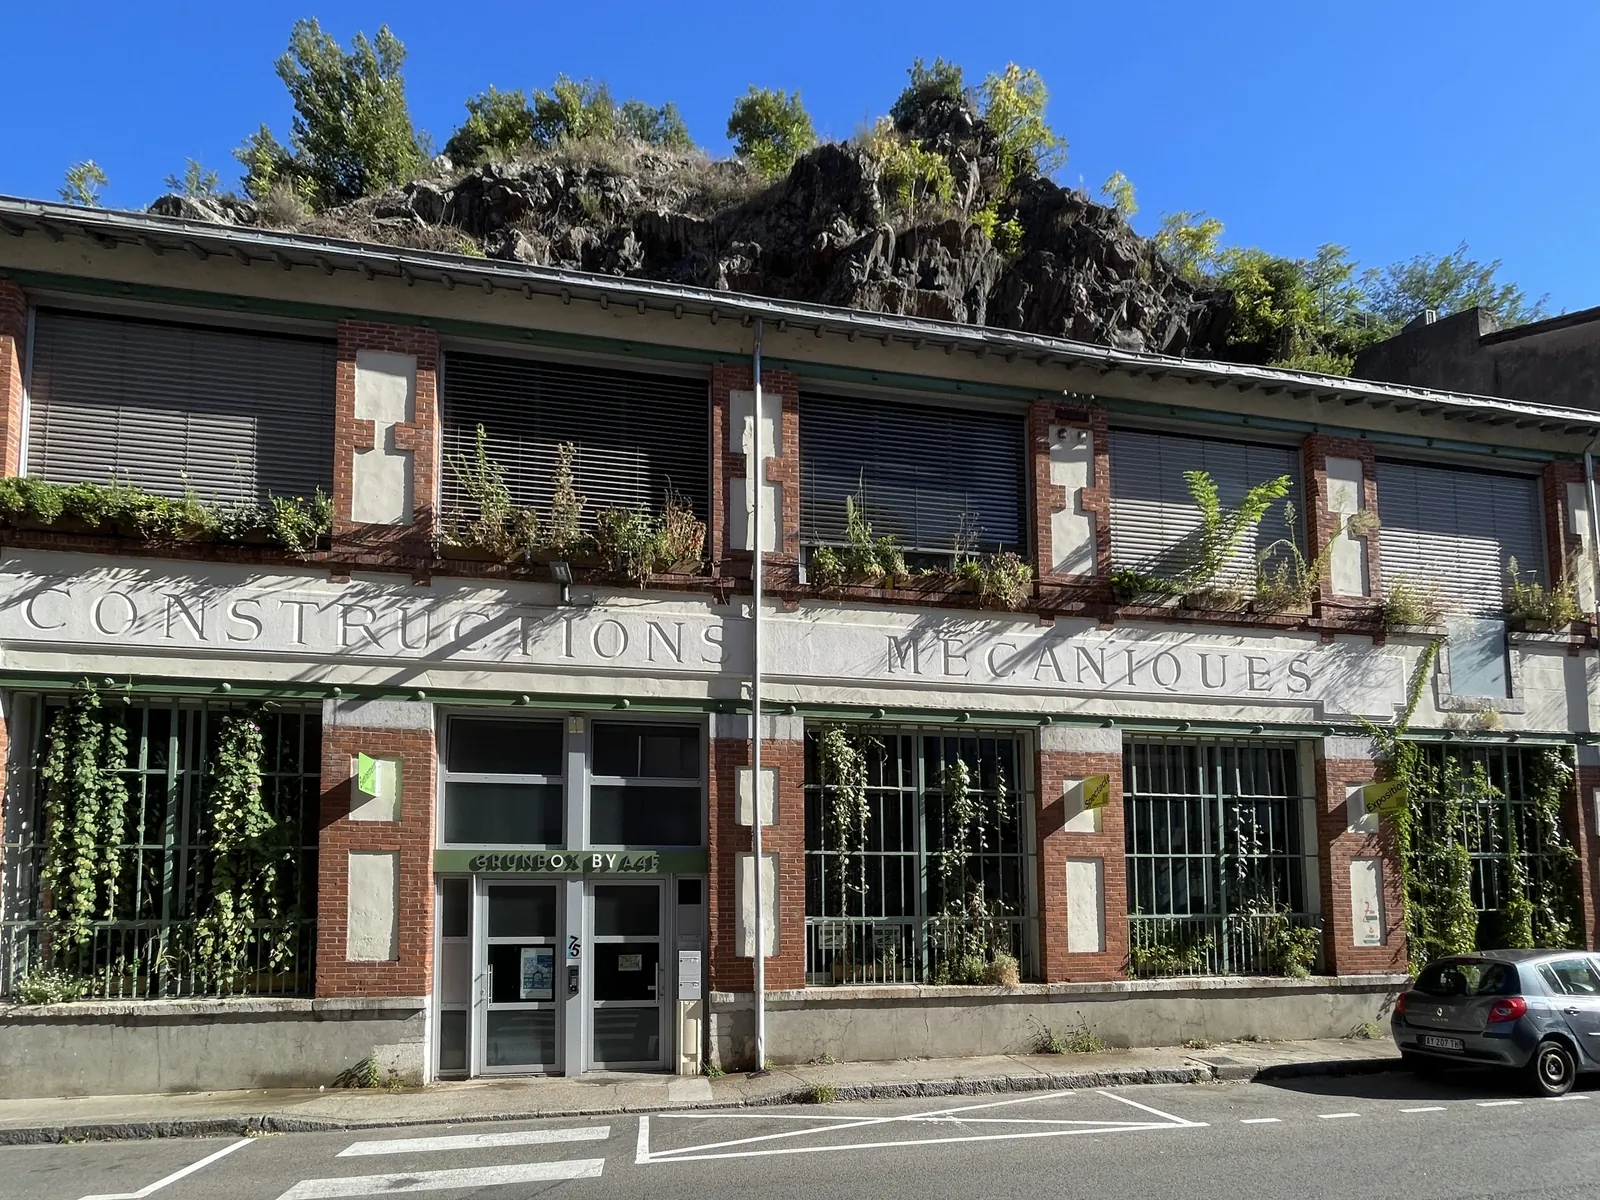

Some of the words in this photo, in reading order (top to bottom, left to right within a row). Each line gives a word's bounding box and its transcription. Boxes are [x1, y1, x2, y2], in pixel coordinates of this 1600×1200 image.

[20, 588, 729, 665] CONSTRUCTIONS
[884, 633, 1313, 694] MECANIQUES
[1366, 780, 1406, 813] Exposition
[472, 853, 580, 869] GRUNBOX
[591, 853, 617, 869] BY
[568, 935, 581, 957] 75
[1436, 1038, 1448, 1047] 207
